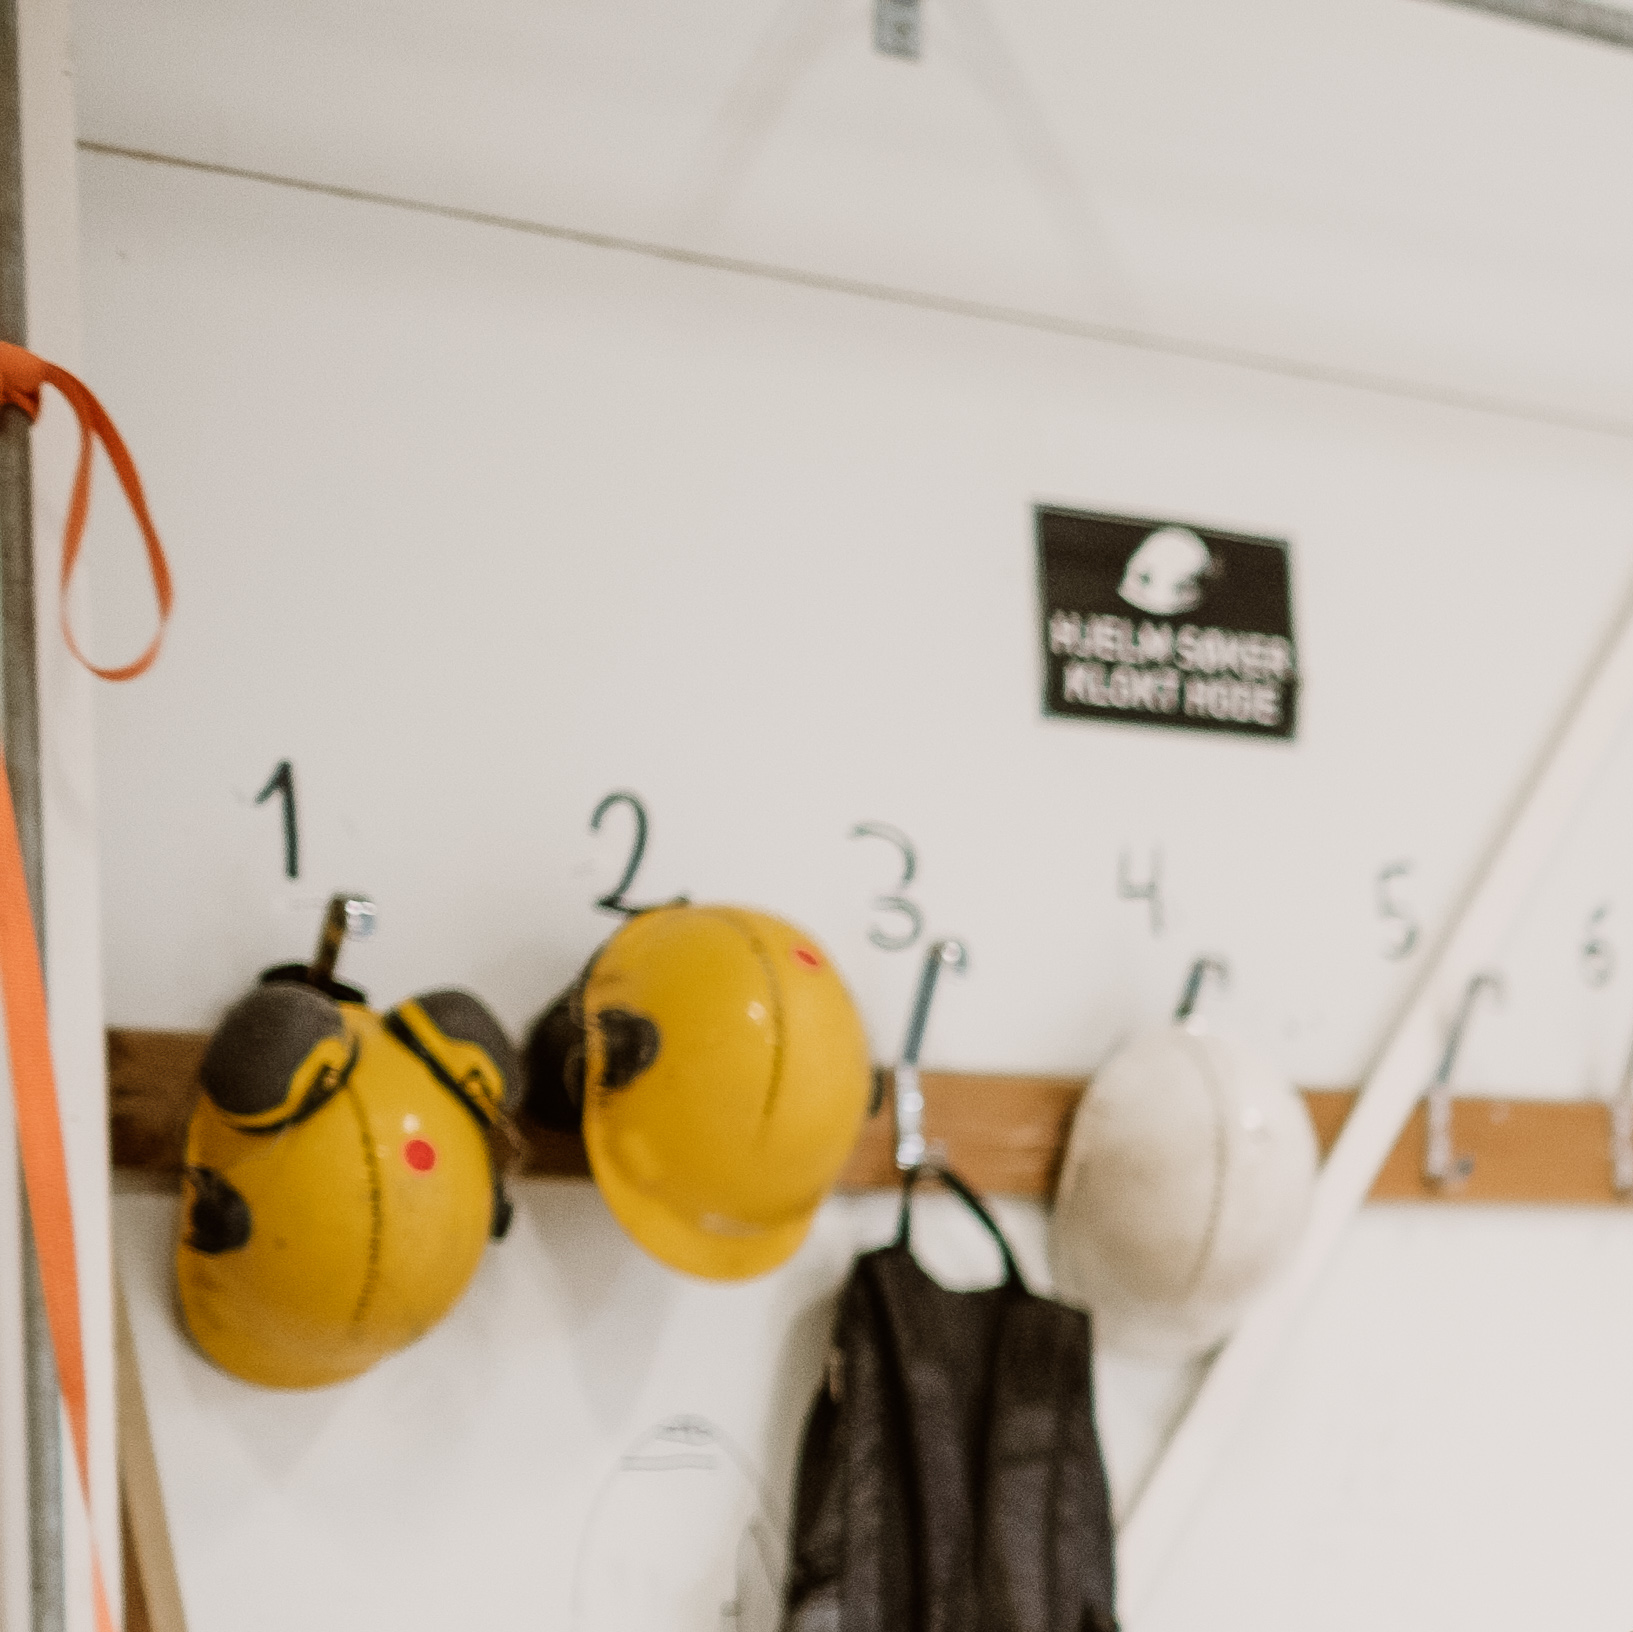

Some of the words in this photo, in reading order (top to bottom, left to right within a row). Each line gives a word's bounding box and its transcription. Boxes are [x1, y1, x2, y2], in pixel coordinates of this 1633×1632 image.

[256, 759, 300, 878] 1
[590, 790, 691, 915] 2
[850, 821, 926, 951] 3
[1116, 843, 1165, 936] 4
[1374, 861, 1420, 961] 5
